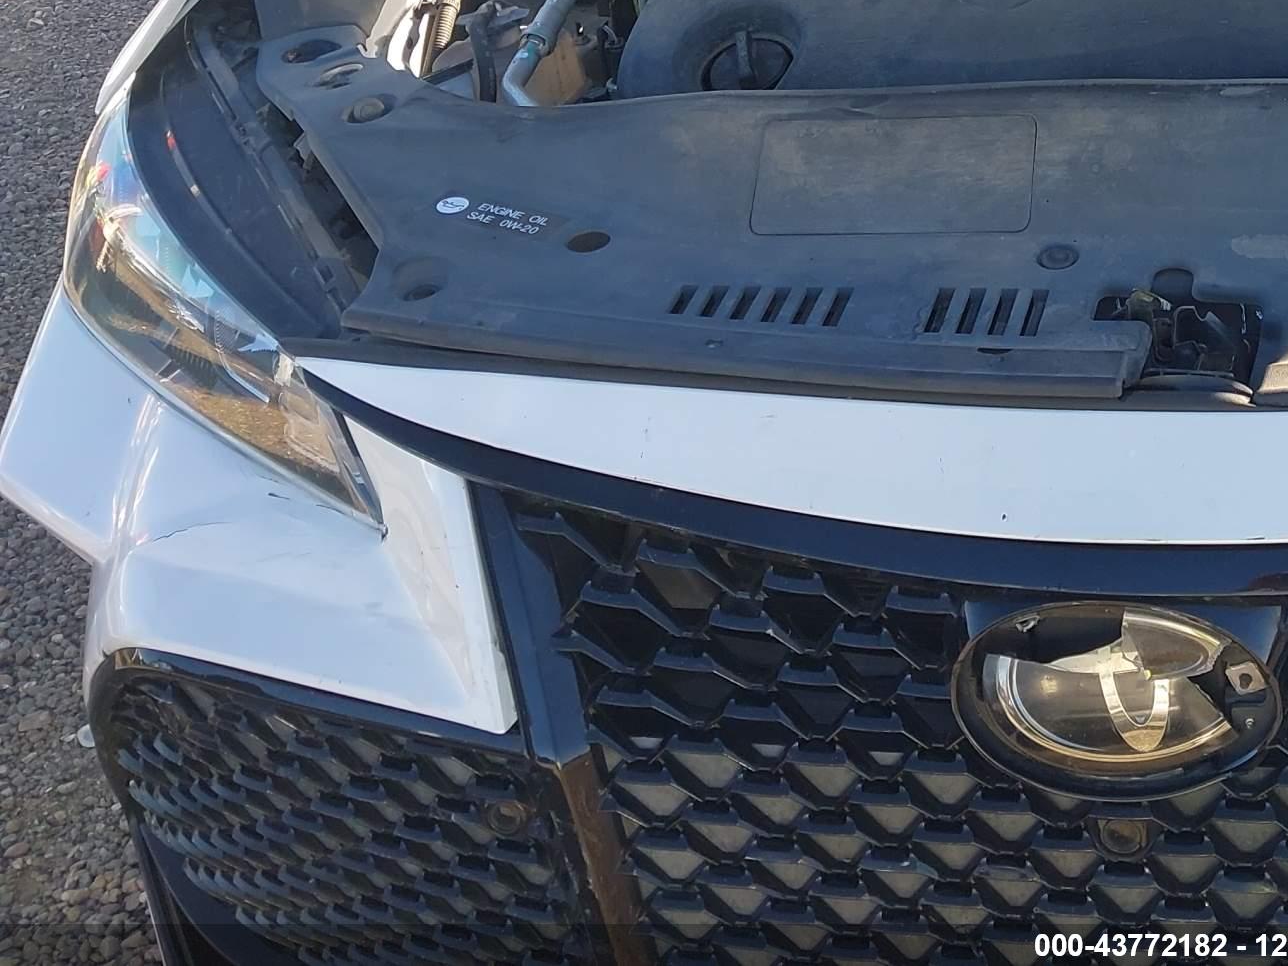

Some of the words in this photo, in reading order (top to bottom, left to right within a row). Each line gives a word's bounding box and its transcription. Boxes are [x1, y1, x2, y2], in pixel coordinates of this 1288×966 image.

[466, 211, 496, 223] SAE
[499, 219, 539, 234] 0W-20
[478, 203, 526, 219] ENGINE
[528, 215, 548, 226] OIL
